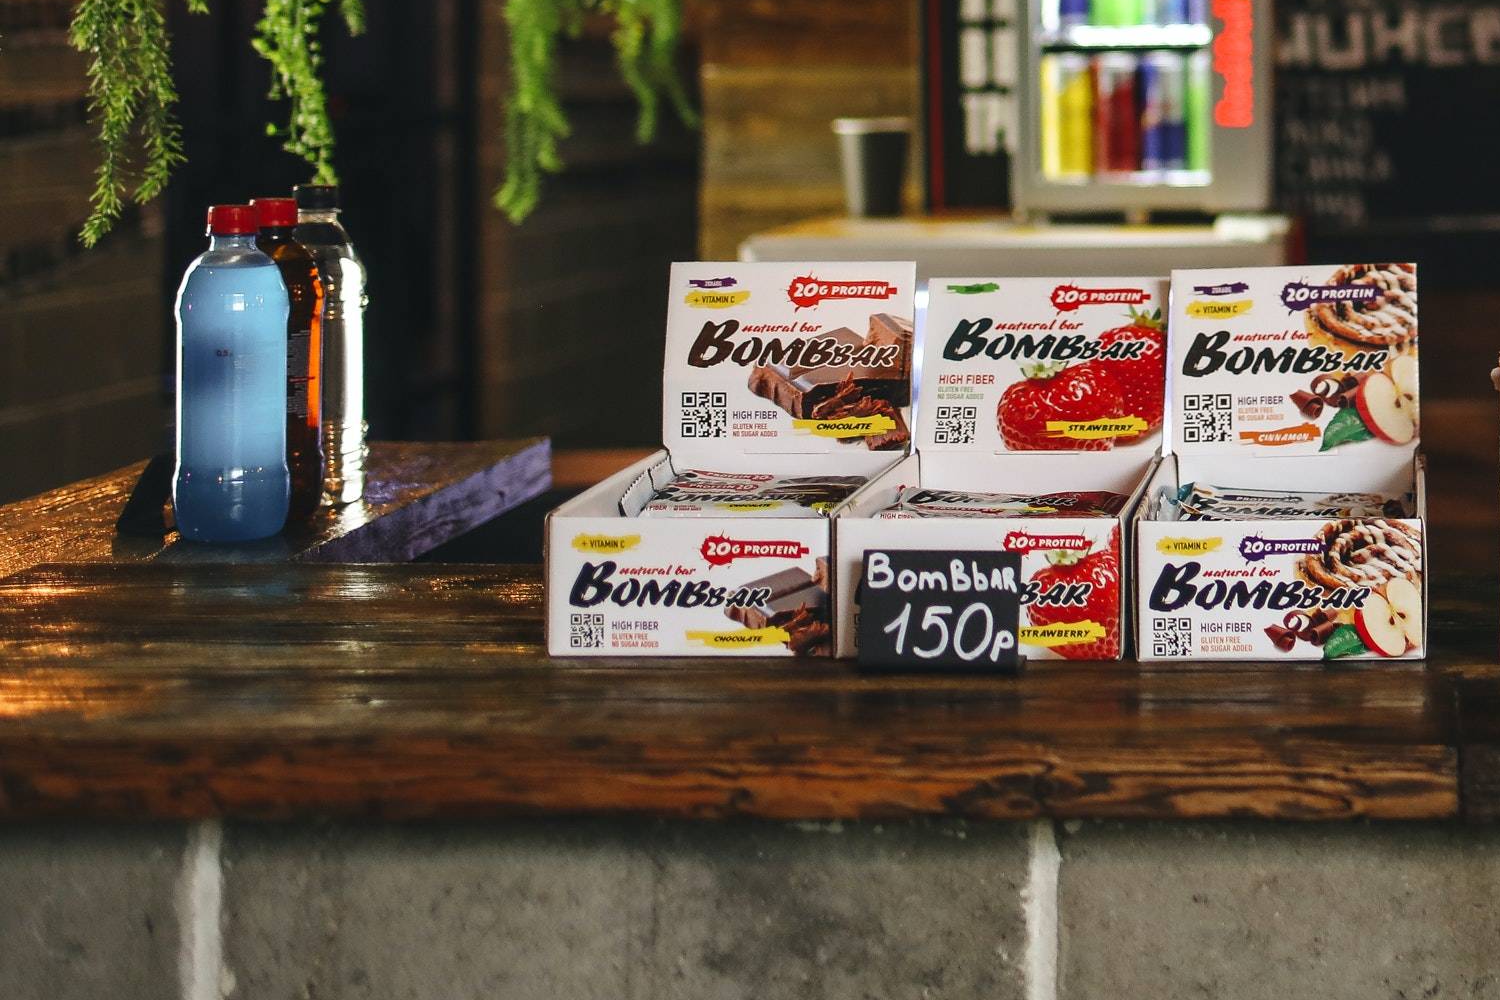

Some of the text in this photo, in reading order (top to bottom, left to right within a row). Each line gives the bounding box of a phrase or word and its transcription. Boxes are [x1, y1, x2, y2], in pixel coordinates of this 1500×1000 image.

[793, 283, 886, 297] 20G PROTEIN
[1286, 287, 1374, 302] 20G PROTEIN
[1056, 290, 1141, 303] 20G PROTEIN
[1203, 305, 1230, 313] VITAMIN
[742, 322, 822, 333] natural bar
[995, 320, 1083, 330] natural bar
[1233, 331, 1312, 342] natural bar
[939, 375, 995, 384] HIGH FIBER
[1238, 396, 1283, 405] HIGH FIBER
[733, 411, 777, 419] HIGH FIBER
[1068, 424, 1133, 432] STRAWBERRY
[1259, 433, 1309, 442] CINNAMON
[589, 539, 625, 549] VITAMIN C
[1008, 536, 1083, 548] 20G PROTEIN
[1174, 541, 1208, 550] VITAMIN C
[707, 542, 799, 557] 20G PROTEIN
[1244, 541, 1319, 554] 20G PROTEIN
[619, 564, 696, 575] natural bar
[1203, 567, 1280, 578] natural bar
[612, 621, 659, 630] HIGH FIBER
[1201, 622, 1252, 633] HIGH FIBER
[1020, 629, 1090, 638] STRAWBERRY
[1232, 644, 1253, 652] ADDED
